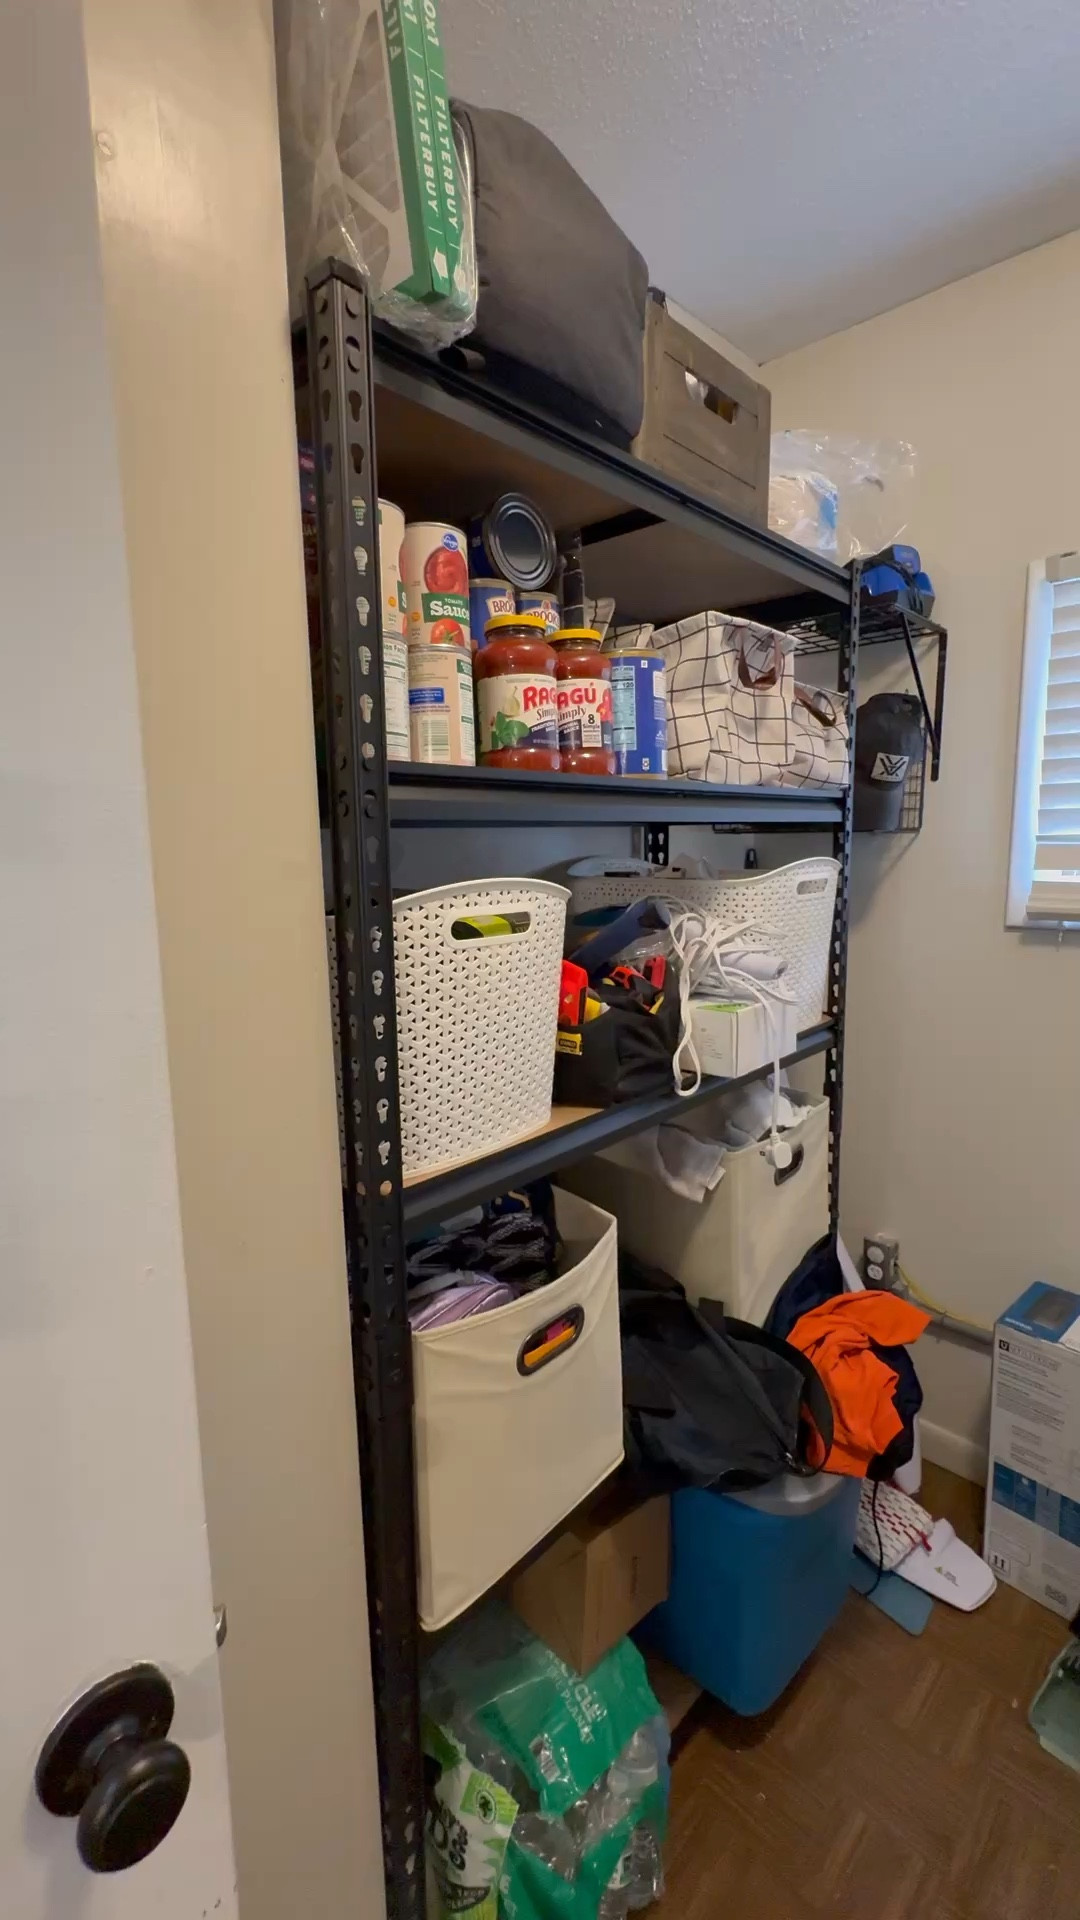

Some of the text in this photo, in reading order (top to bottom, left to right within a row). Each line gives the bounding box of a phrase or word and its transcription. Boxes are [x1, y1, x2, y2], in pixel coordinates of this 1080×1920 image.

[413, 74, 438, 216] FILTERBUY
[434, 95, 459, 231] FILTERBUY
[587, 713, 596, 725] 8
